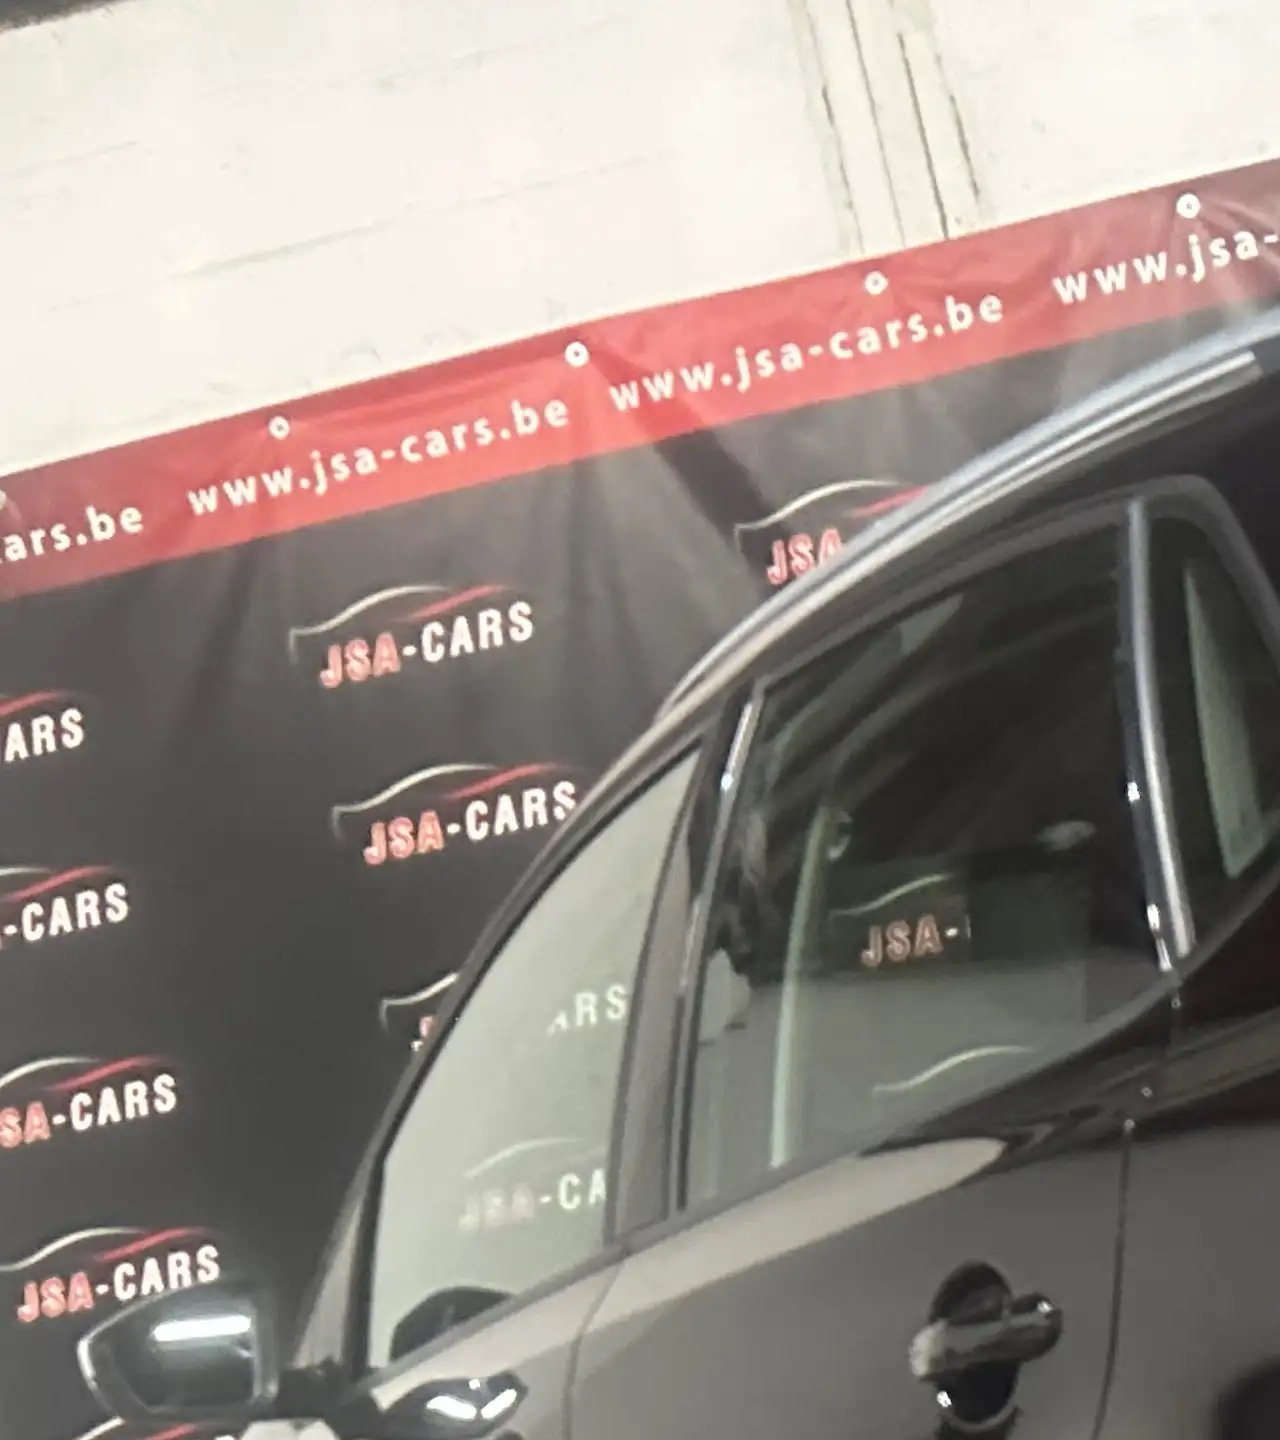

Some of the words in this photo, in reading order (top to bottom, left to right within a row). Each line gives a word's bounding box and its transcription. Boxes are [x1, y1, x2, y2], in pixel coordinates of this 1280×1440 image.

[609, 293, 1005, 412] www.jsa-cars.be
[188, 397, 569, 516] www.jsa-cars.be
[0, 505, 144, 564] ars.be
[319, 601, 536, 688] JSA-CARS
[363, 780, 578, 866] JSA-CARS
[0, 883, 128, 950] -CARS
[860, 912, 971, 969] JSA-
[17, 1244, 220, 1323] JSA-CARS
